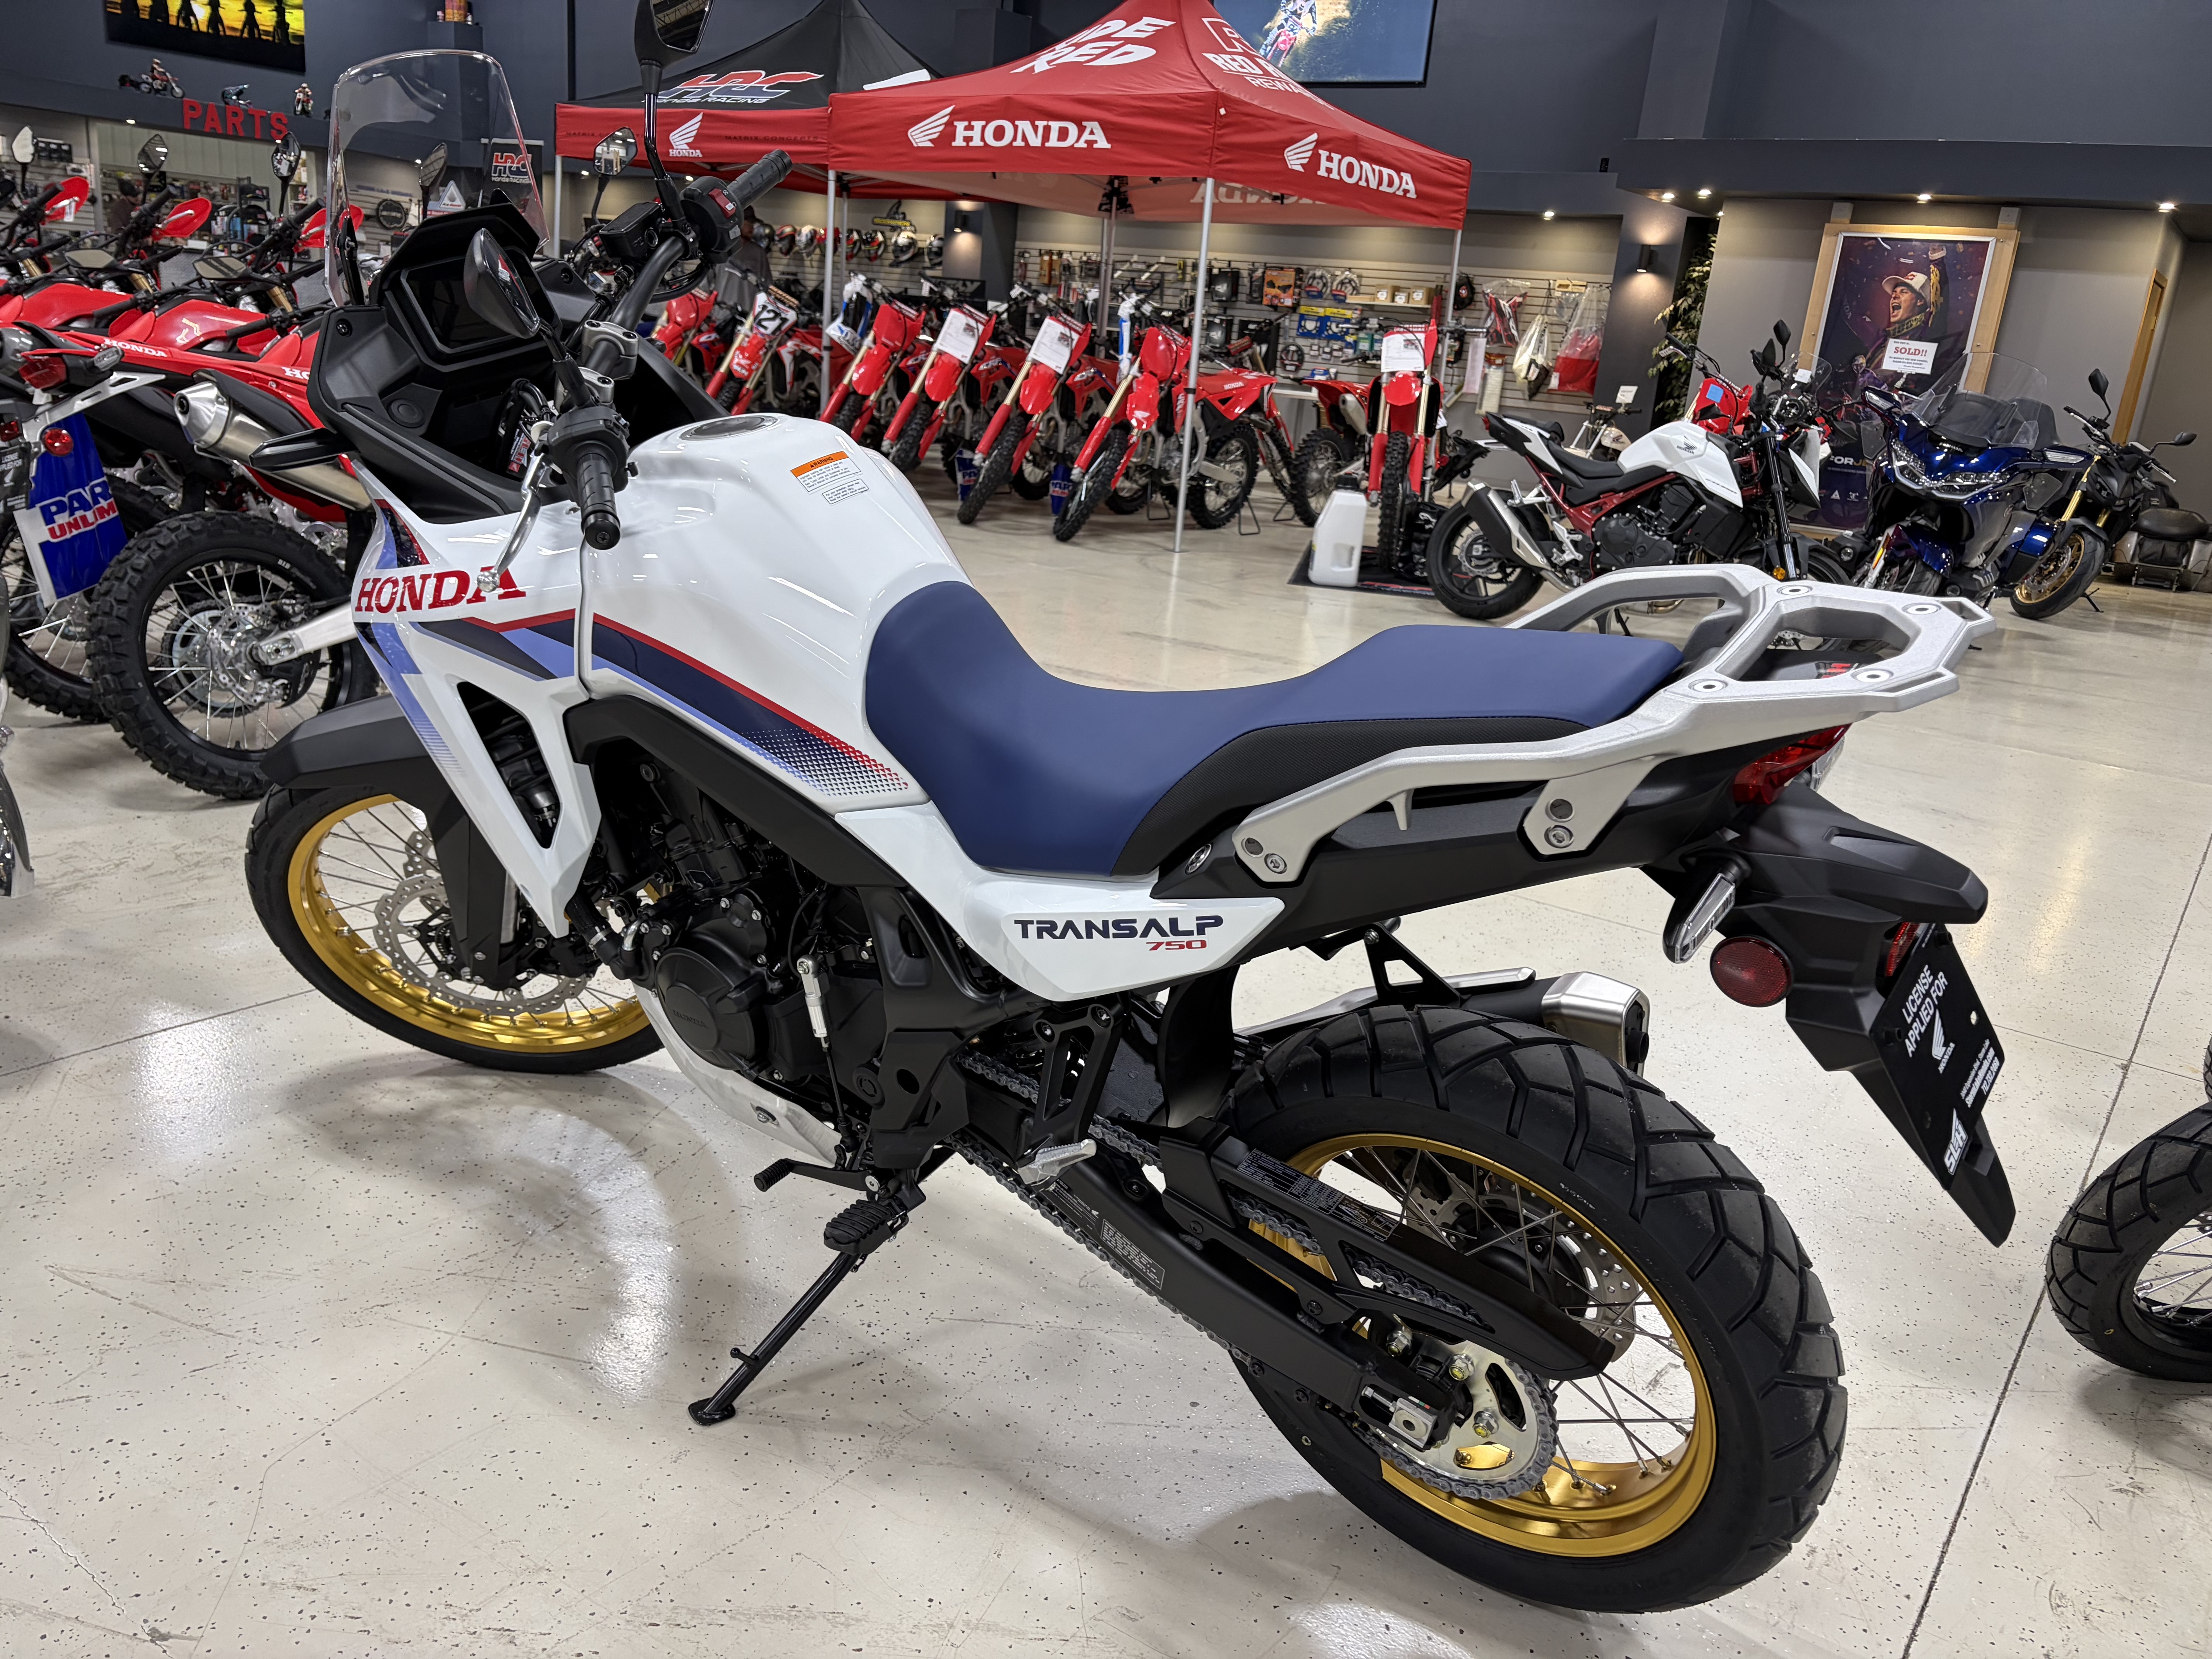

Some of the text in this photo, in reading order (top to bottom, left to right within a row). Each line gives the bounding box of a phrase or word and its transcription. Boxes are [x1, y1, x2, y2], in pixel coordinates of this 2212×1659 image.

[1010, 40, 1157, 74] RED
[1202, 53, 1264, 74] RED
[182, 98, 288, 139] PARTS
[951, 120, 1111, 149] HONDA
[669, 149, 703, 158] HONDA
[1317, 149, 1417, 199] HONDA
[754, 304, 789, 335] 121
[103, 338, 168, 357] HONDA
[1894, 347, 1927, 357] SOLD!!
[813, 456, 834, 466] WARNING
[39, 479, 112, 526] PAR
[48, 500, 117, 539] UNLIM
[355, 565, 526, 614] HONDA
[1013, 915, 1224, 939] TRANSALP
[1146, 939, 1207, 951] 750
[1901, 964, 1933, 1025] LICENSE
[672, 1009, 709, 1029] HONDA
[1904, 971, 1949, 1058] APPLIED FOR
[1938, 1042, 1956, 1075] HONDA
